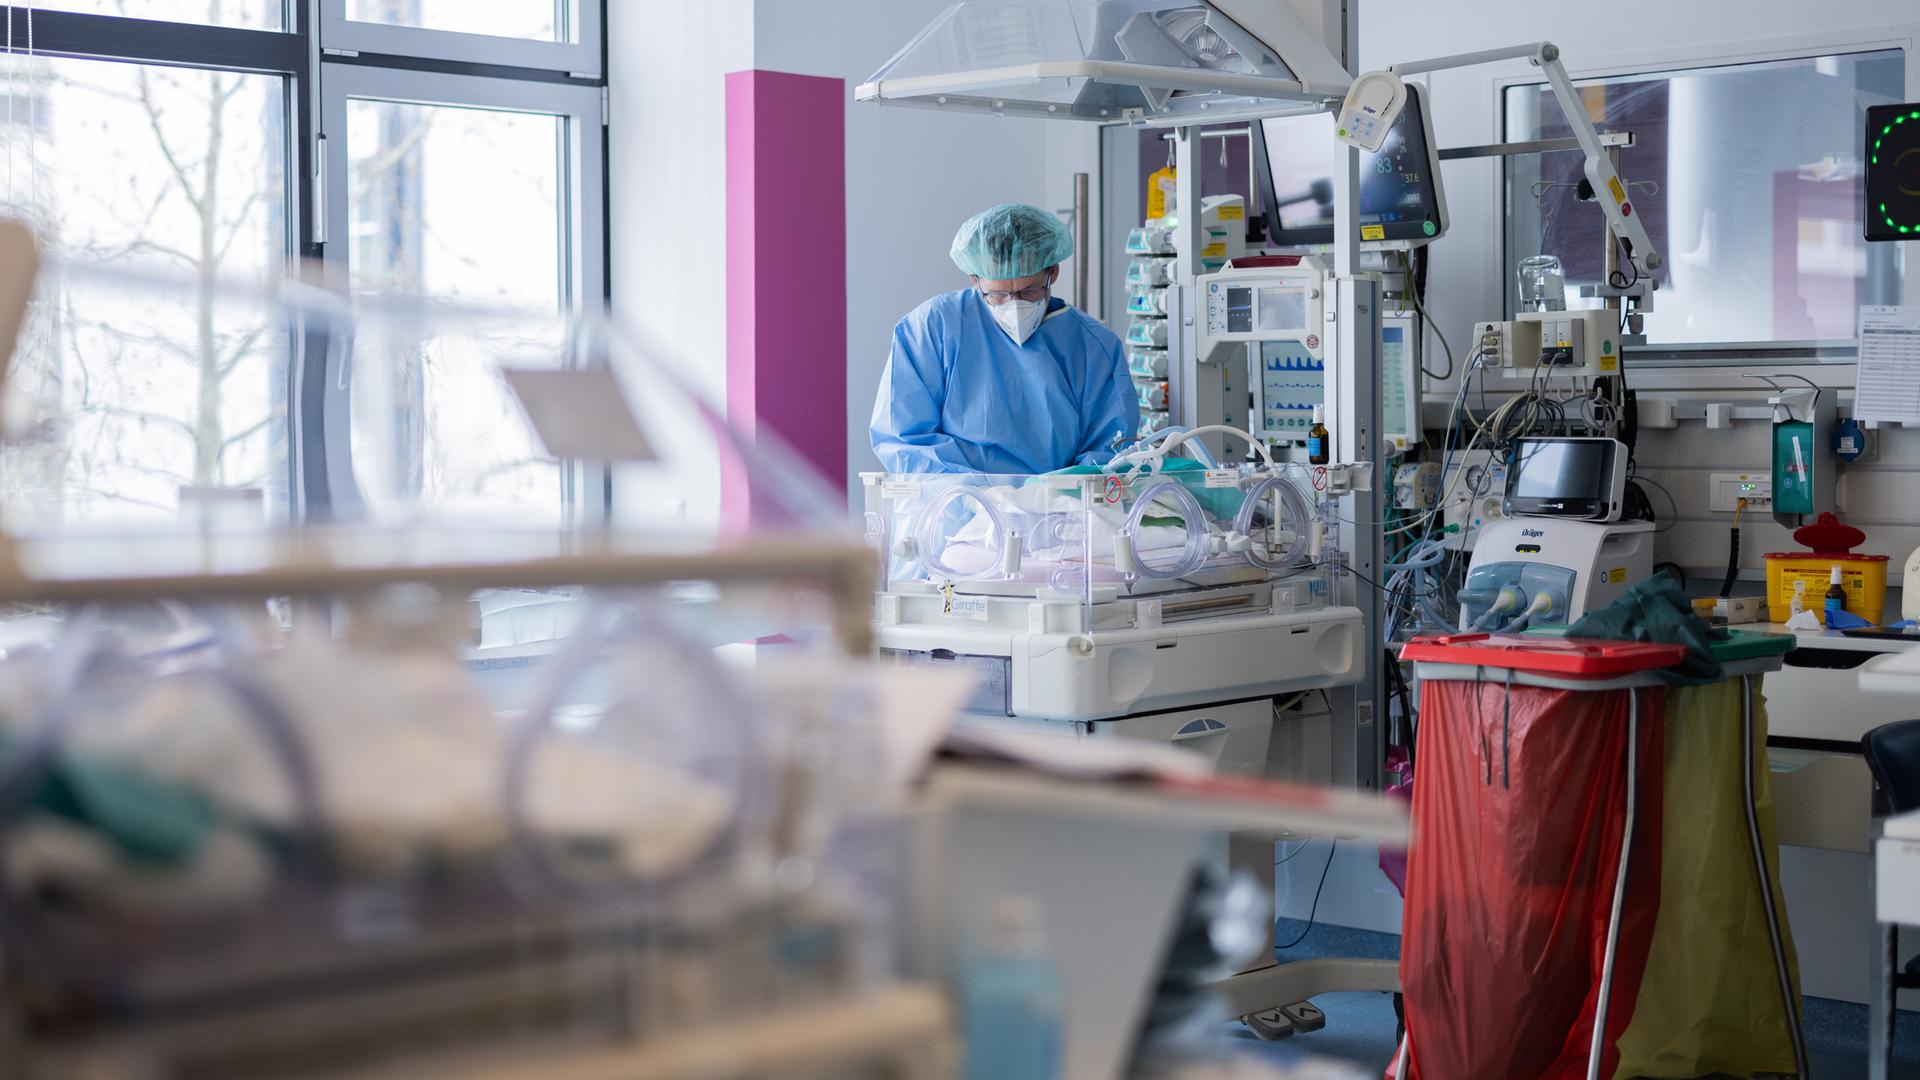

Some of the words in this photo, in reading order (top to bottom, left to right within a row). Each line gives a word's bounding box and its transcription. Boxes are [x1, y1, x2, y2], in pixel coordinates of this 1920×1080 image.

[1376, 158, 1393, 173] 83
[1521, 528, 1544, 538] Dräger
[952, 598, 985, 612] Giraffe
